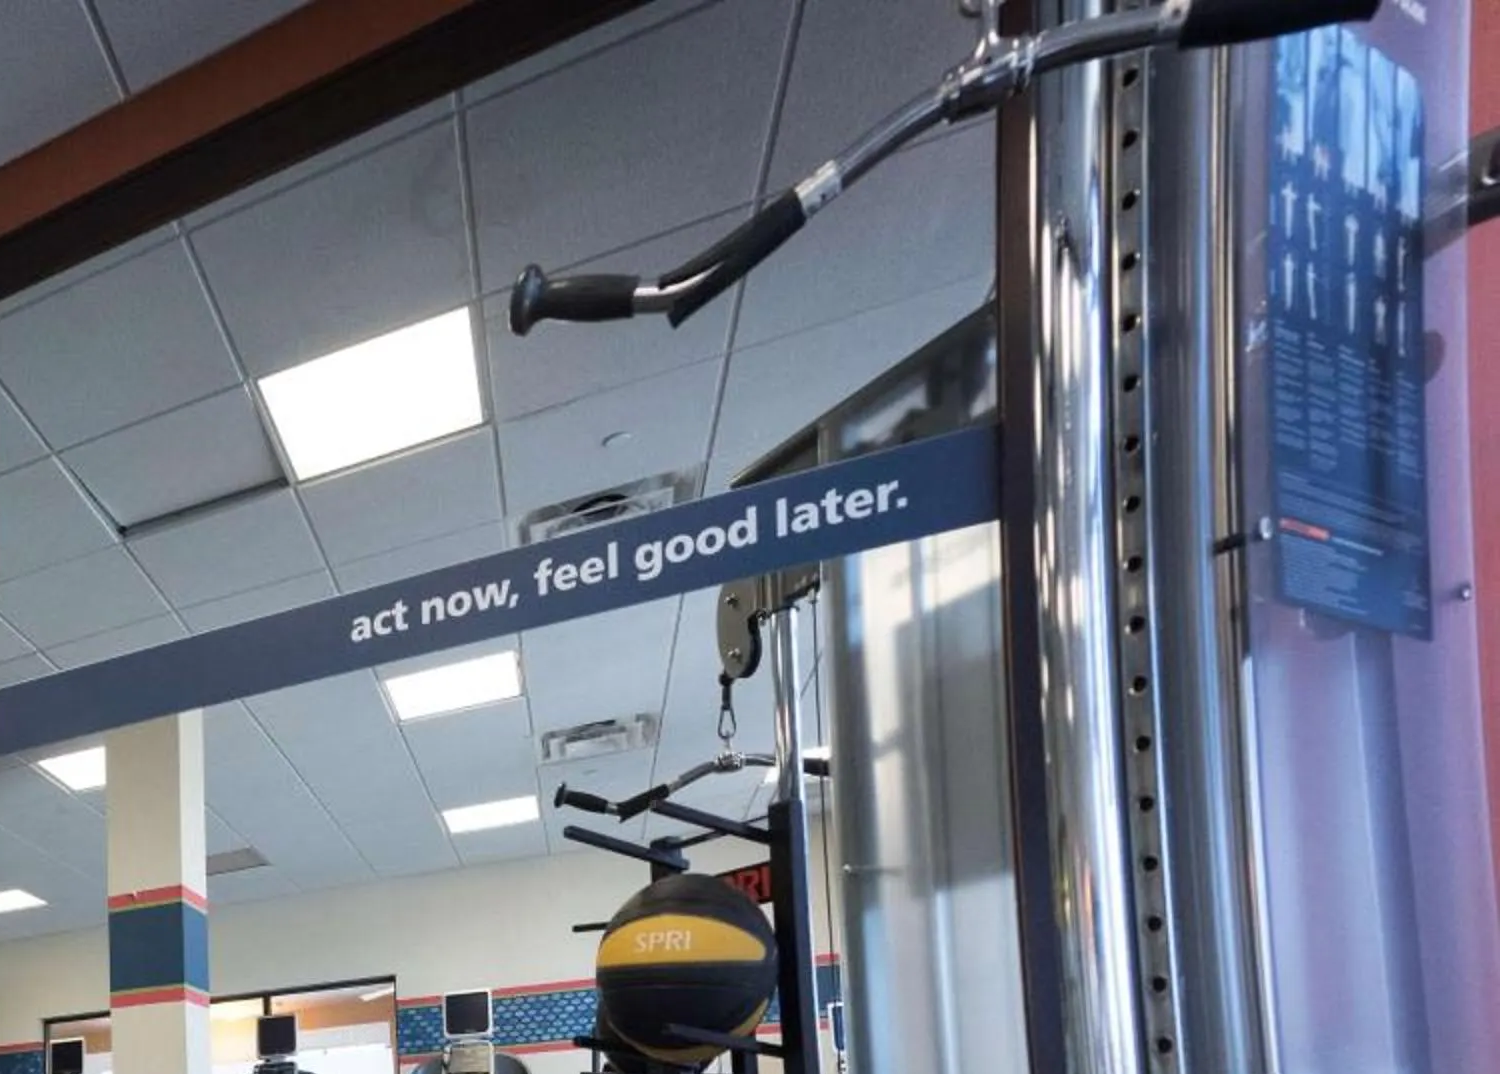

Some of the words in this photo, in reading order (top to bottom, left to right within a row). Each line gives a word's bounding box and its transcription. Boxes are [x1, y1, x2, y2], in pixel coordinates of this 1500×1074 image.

[351, 599, 410, 642] act
[421, 579, 519, 625] now,
[533, 541, 618, 597] feel
[634, 505, 758, 582] good
[775, 479, 908, 538] later.
[634, 929, 691, 953] SPRI
